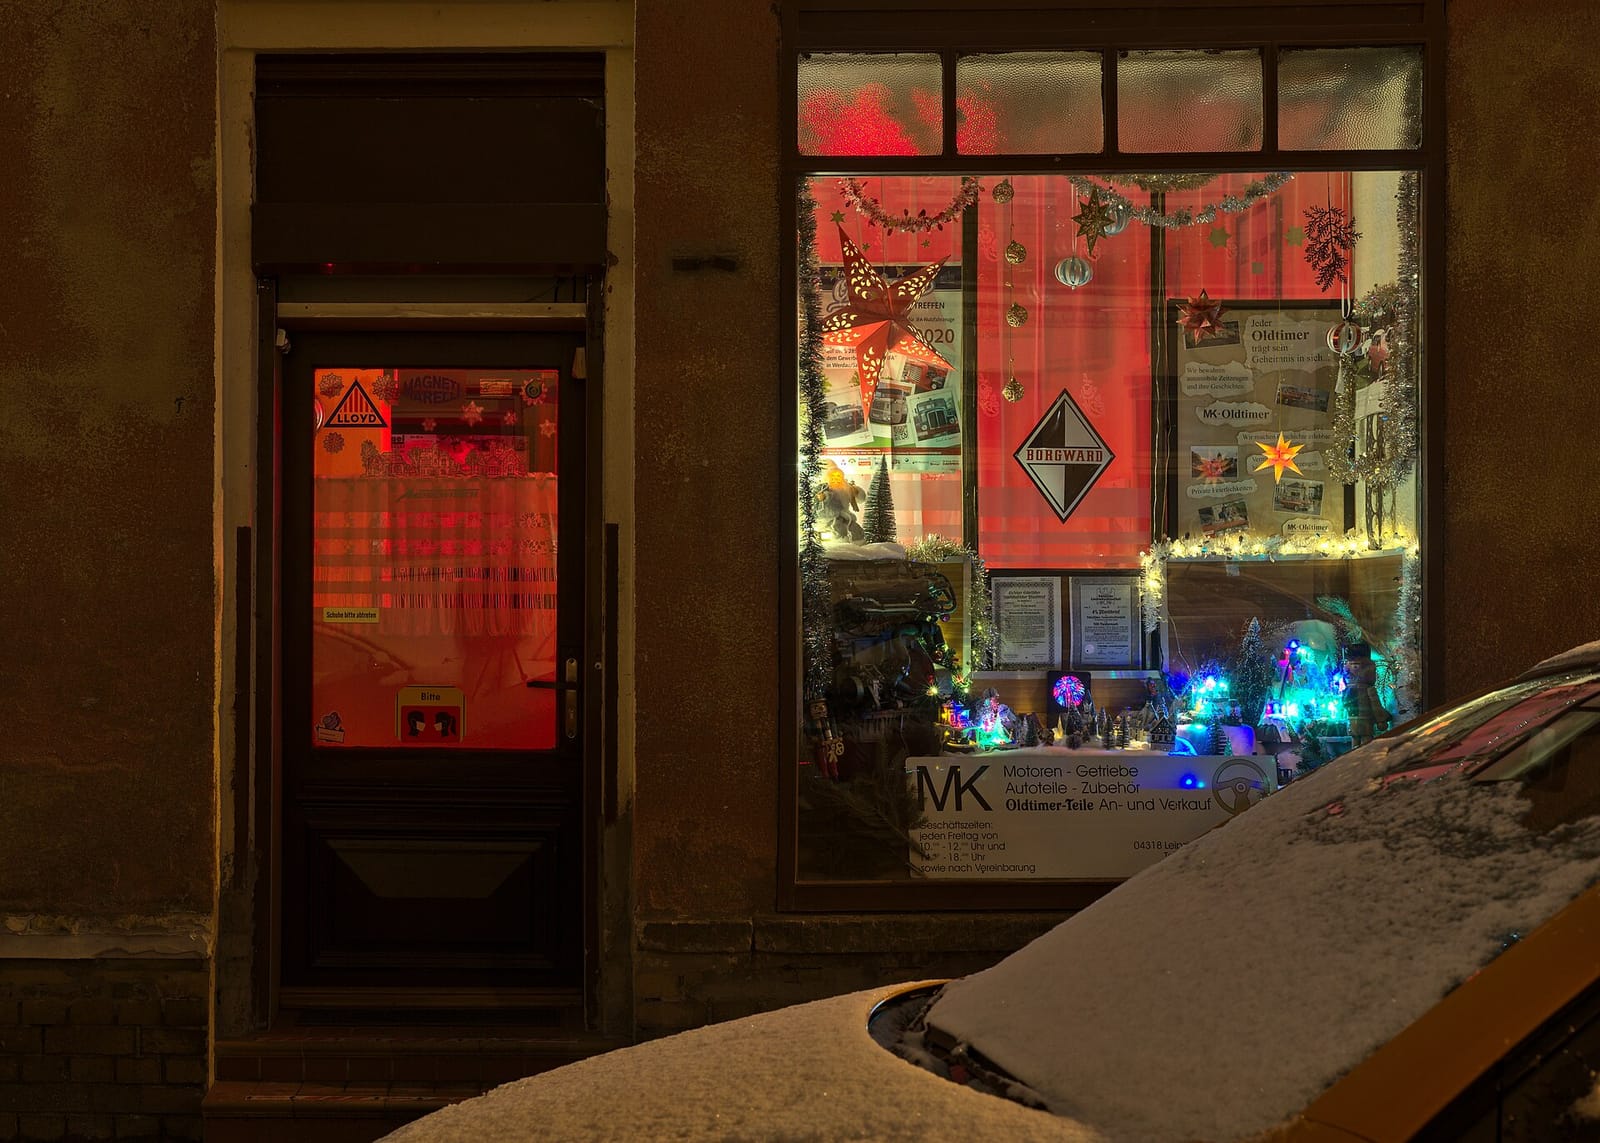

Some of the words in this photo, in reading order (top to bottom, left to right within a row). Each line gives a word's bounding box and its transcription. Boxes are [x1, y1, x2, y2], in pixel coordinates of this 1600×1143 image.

[1251, 319, 1272, 328] Jeder
[918, 329, 955, 343] 020
[1251, 329, 1310, 341] Oldtimer
[1251, 345, 1271, 354] trägt
[1297, 354, 1304, 362] in
[337, 414, 377, 423] LLOYD
[1026, 449, 1103, 462] BORGWARD
[420, 692, 441, 702] Bitte
[1004, 765, 1062, 778] Motoren
[1076, 765, 1138, 778] Getriebe
[916, 766, 993, 811] MK
[1005, 782, 1067, 795] Autoteile
[1081, 782, 1140, 795] Zubehör
[1006, 798, 1094, 811] Oldtimer-Teile
[1099, 798, 1123, 811] An-
[1127, 798, 1155, 811] und
[1159, 798, 1212, 811] Verkauf
[919, 832, 946, 842] jeden
[948, 831, 979, 842] Freitag
[971, 842, 985, 851] Uhr
[987, 842, 1006, 851] und
[1133, 840, 1162, 850] 04318
[971, 852, 986, 861] Uhr
[920, 863, 946, 872] sowie
[948, 863, 973, 872] nach
[974, 863, 1036, 874] Vereinbarung
